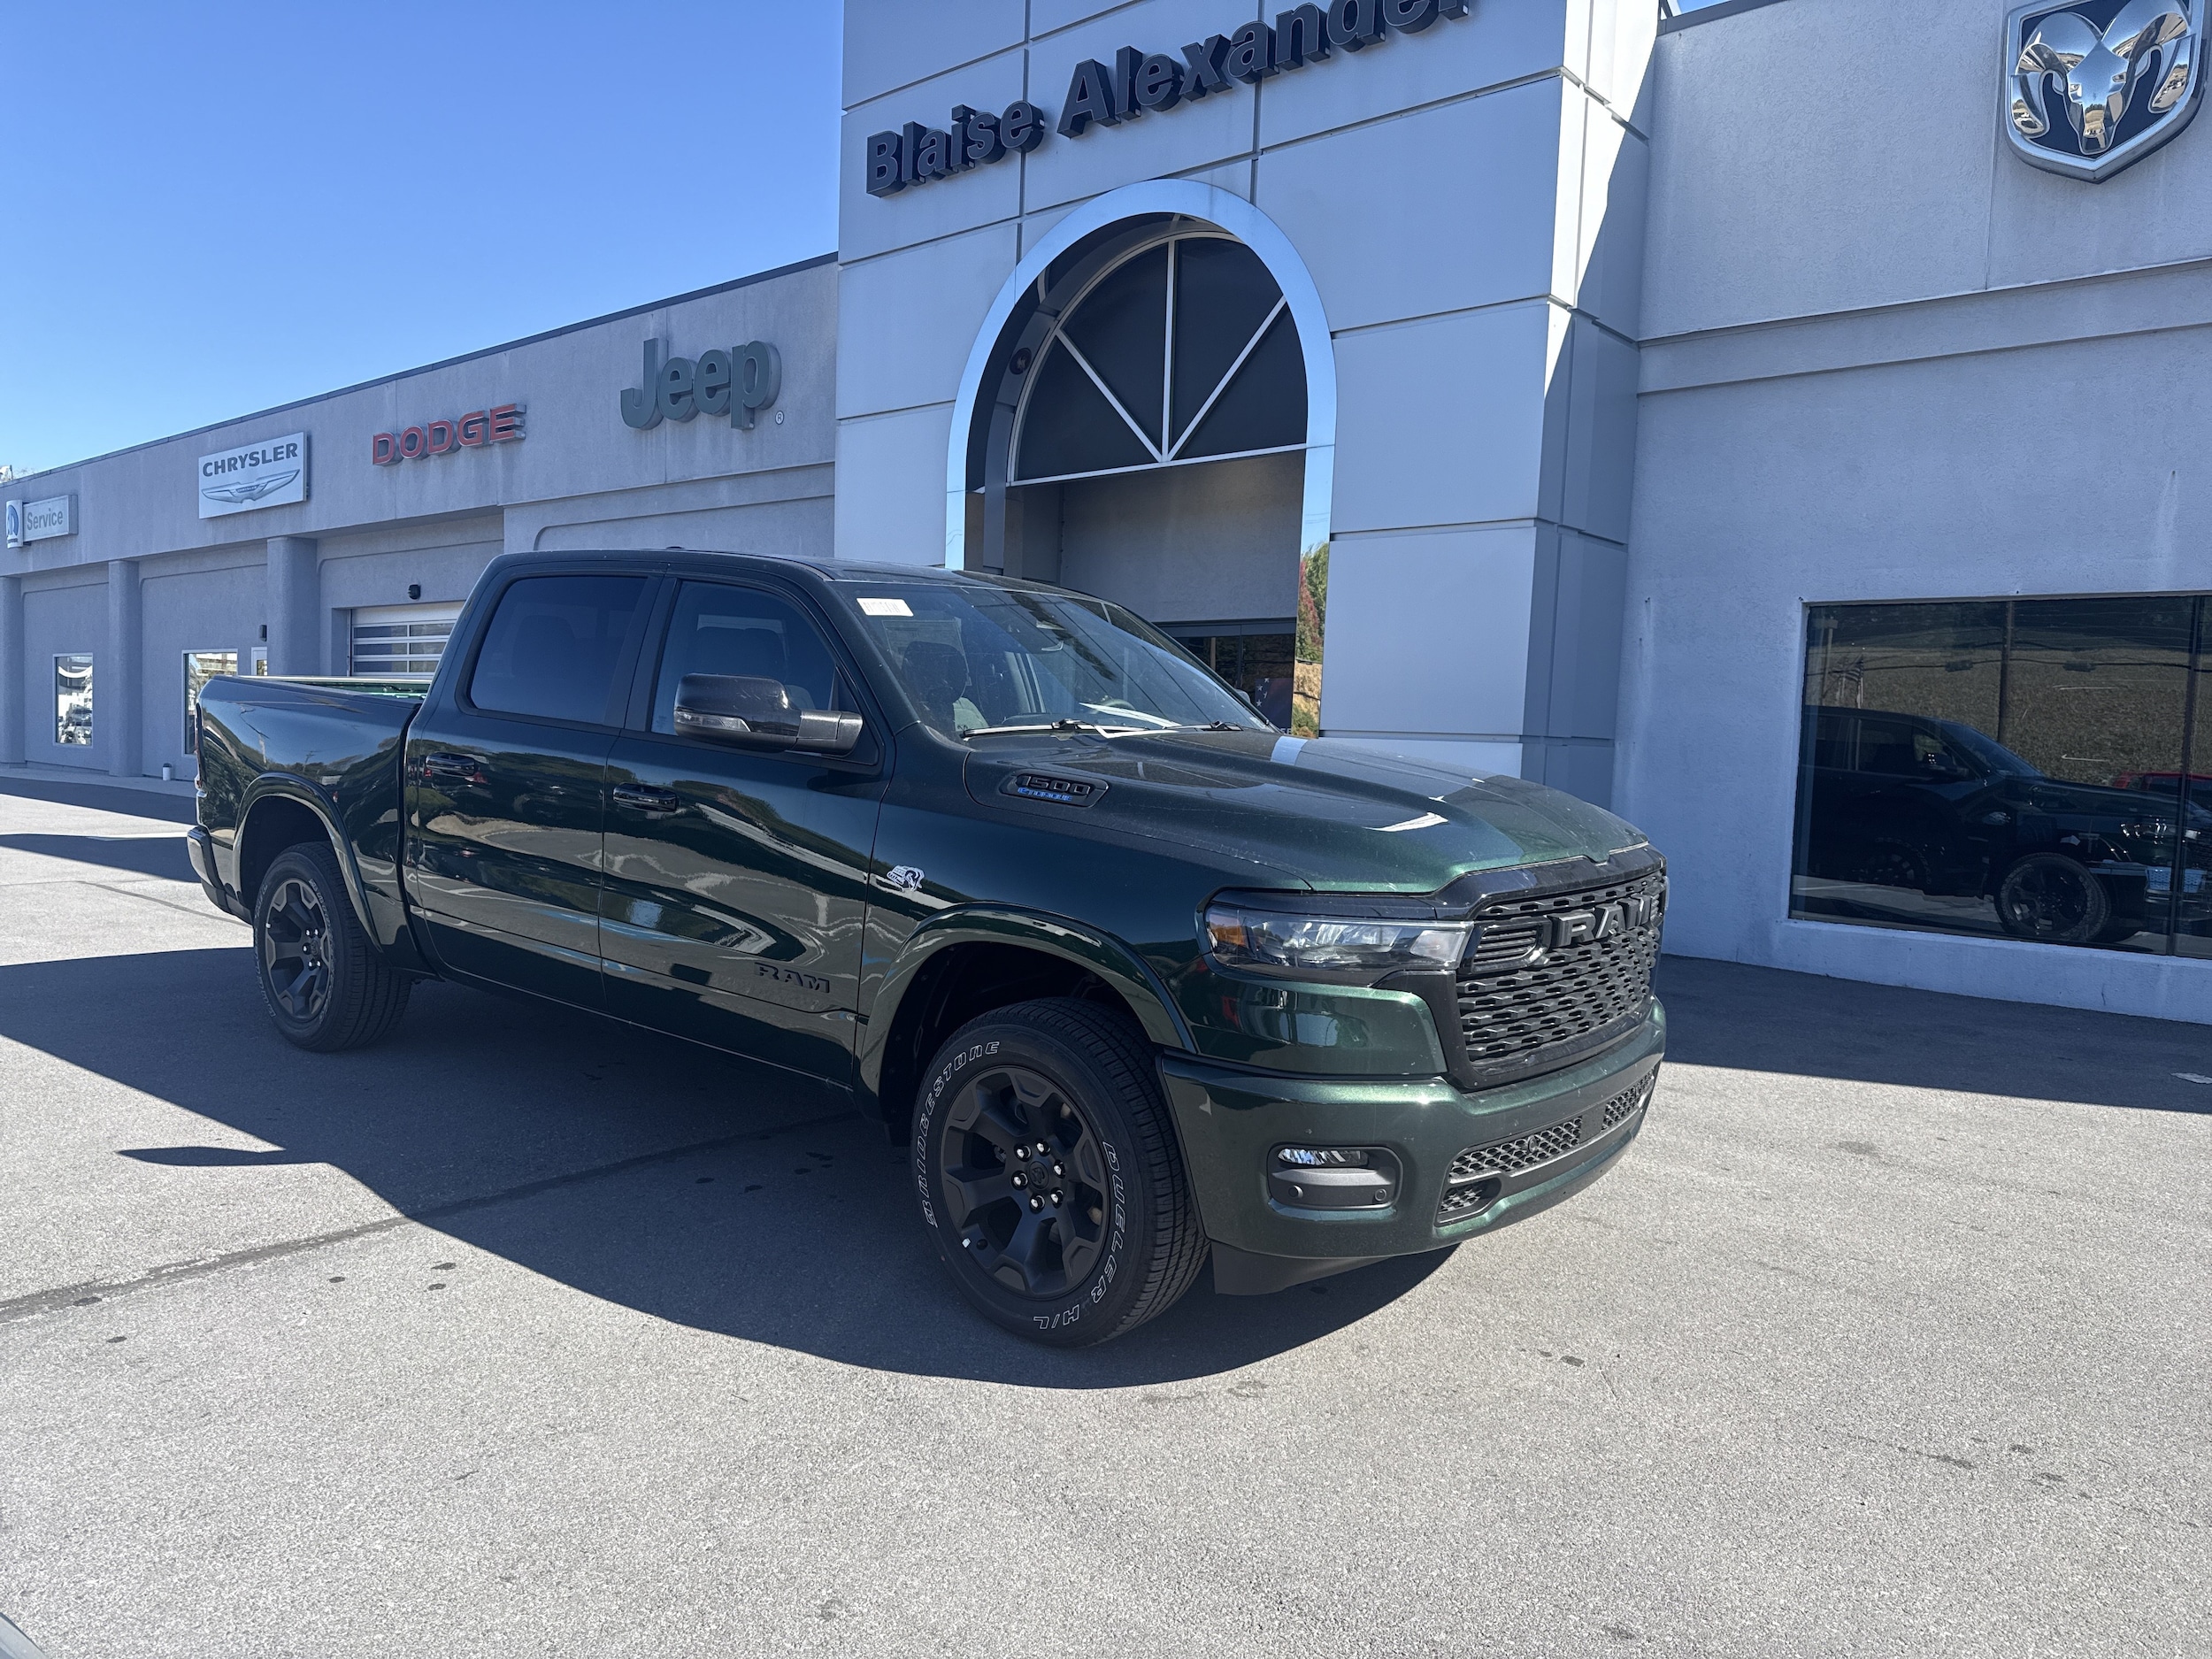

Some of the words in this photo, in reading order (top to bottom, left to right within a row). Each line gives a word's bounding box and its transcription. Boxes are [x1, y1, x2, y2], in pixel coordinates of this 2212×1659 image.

[866, 100, 1045, 198] Blaise
[1057, 0, 1469, 139] Alexand
[620, 337, 782, 431] Jeep
[373, 403, 526, 466] DODGE
[203, 442, 298, 477] CHRYSLER
[27, 507, 64, 531] Service
[1021, 775, 1091, 795] 1500
[755, 962, 830, 994] RAM
[917, 1041, 1000, 1229] BRIDGESTONE
[1090, 1141, 1126, 1304] DUELER
[1033, 1303, 1080, 1330] H/L
